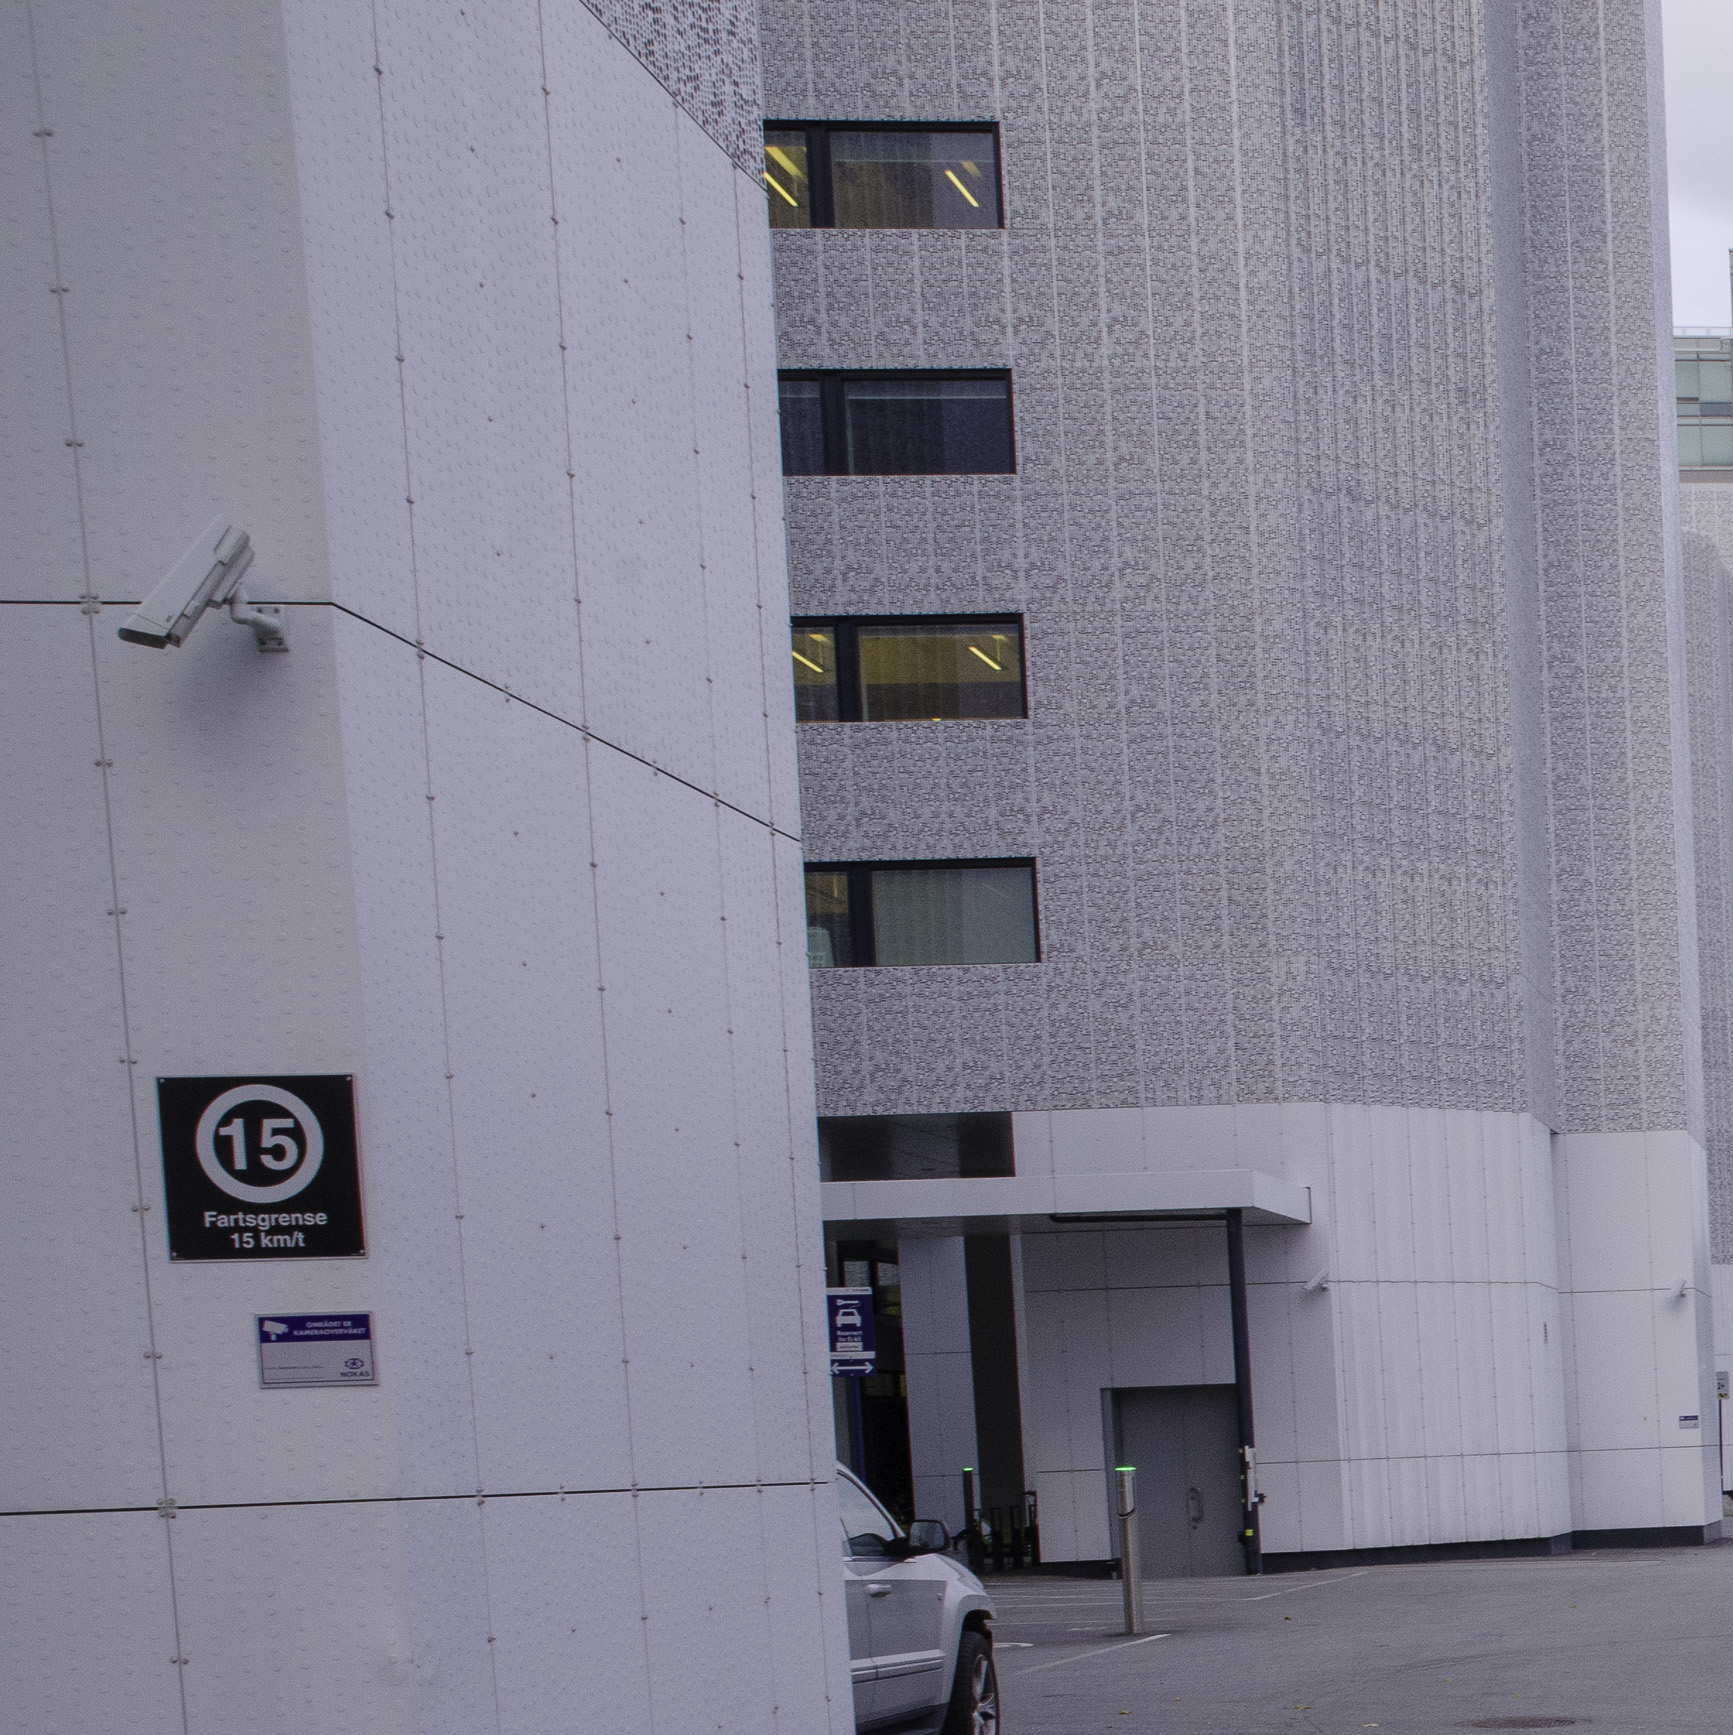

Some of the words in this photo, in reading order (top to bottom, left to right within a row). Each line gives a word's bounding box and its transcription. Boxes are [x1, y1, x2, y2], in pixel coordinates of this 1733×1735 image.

[218, 1118, 299, 1171] 15
[203, 1211, 328, 1230] Fartsgrense
[230, 1232, 254, 1248] 15
[260, 1232, 306, 1248] km/t
[340, 1370, 370, 1378] NOKAS
